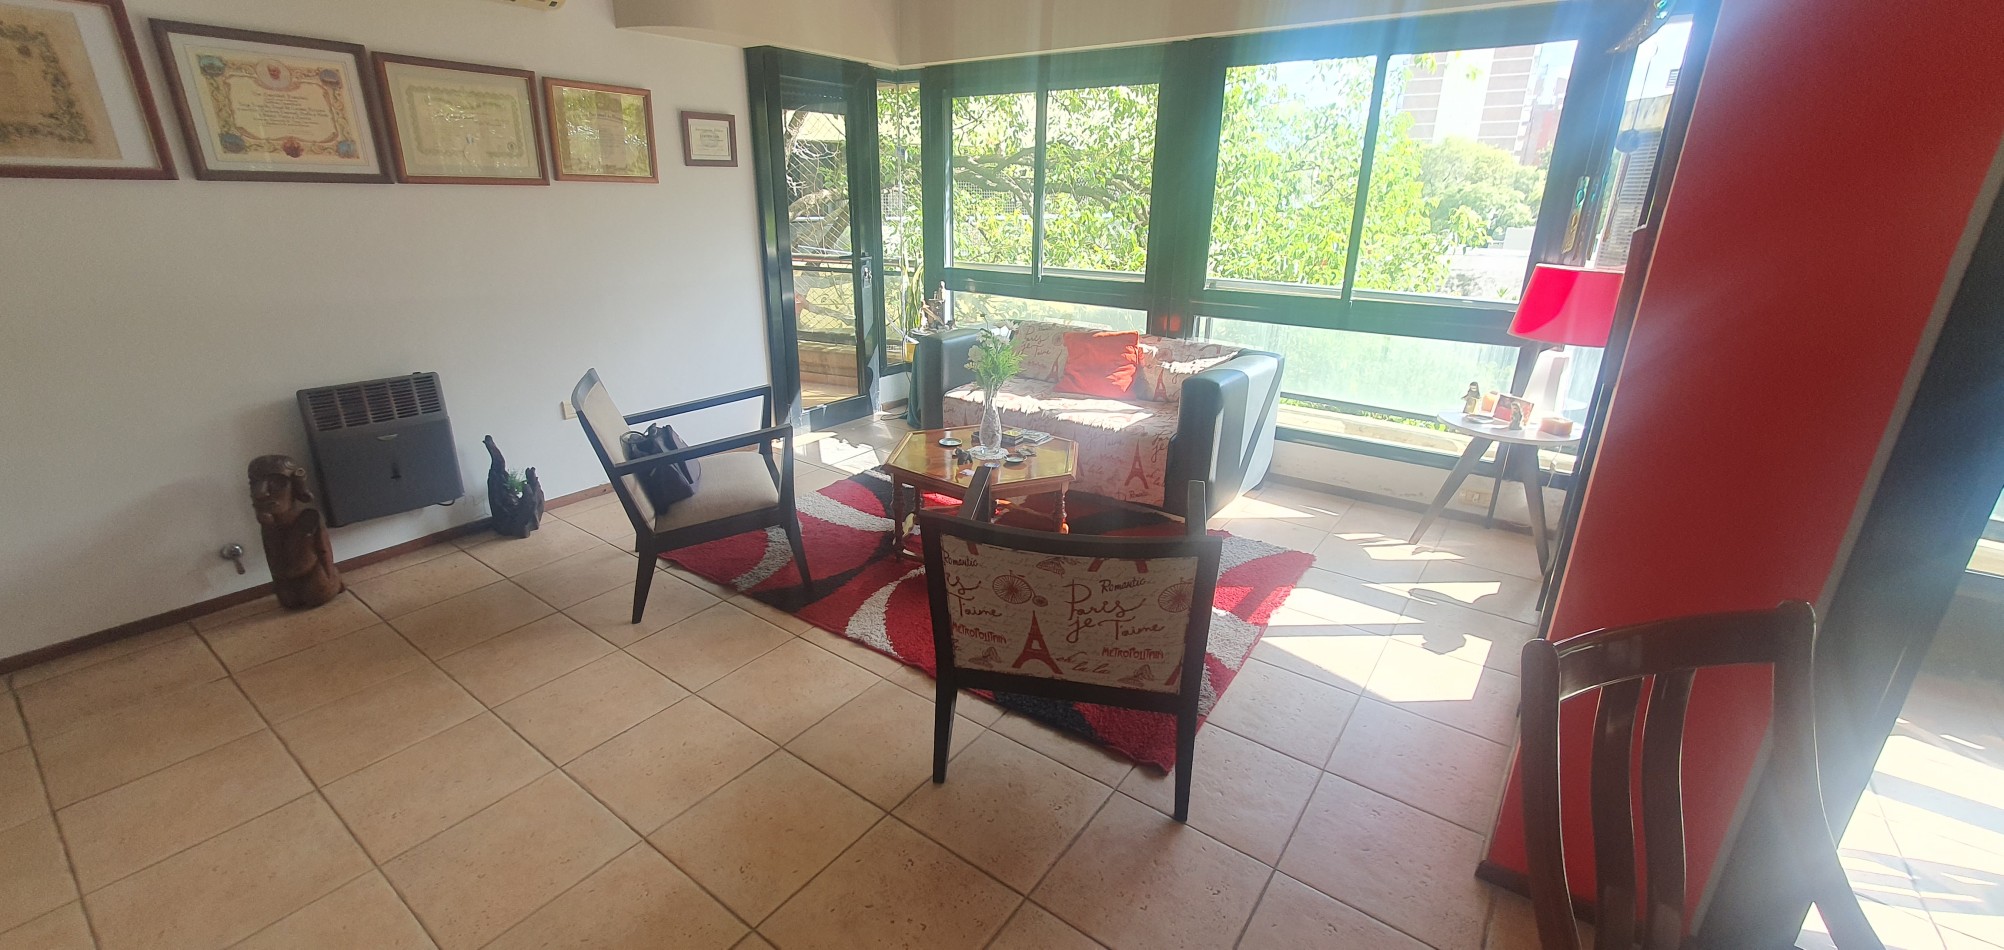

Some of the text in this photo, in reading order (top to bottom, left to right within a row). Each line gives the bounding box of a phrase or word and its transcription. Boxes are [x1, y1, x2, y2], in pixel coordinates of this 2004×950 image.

[1099, 577, 1147, 594] Romantic
[1063, 579, 1146, 620] Paris
[1066, 617, 1096, 643] je
